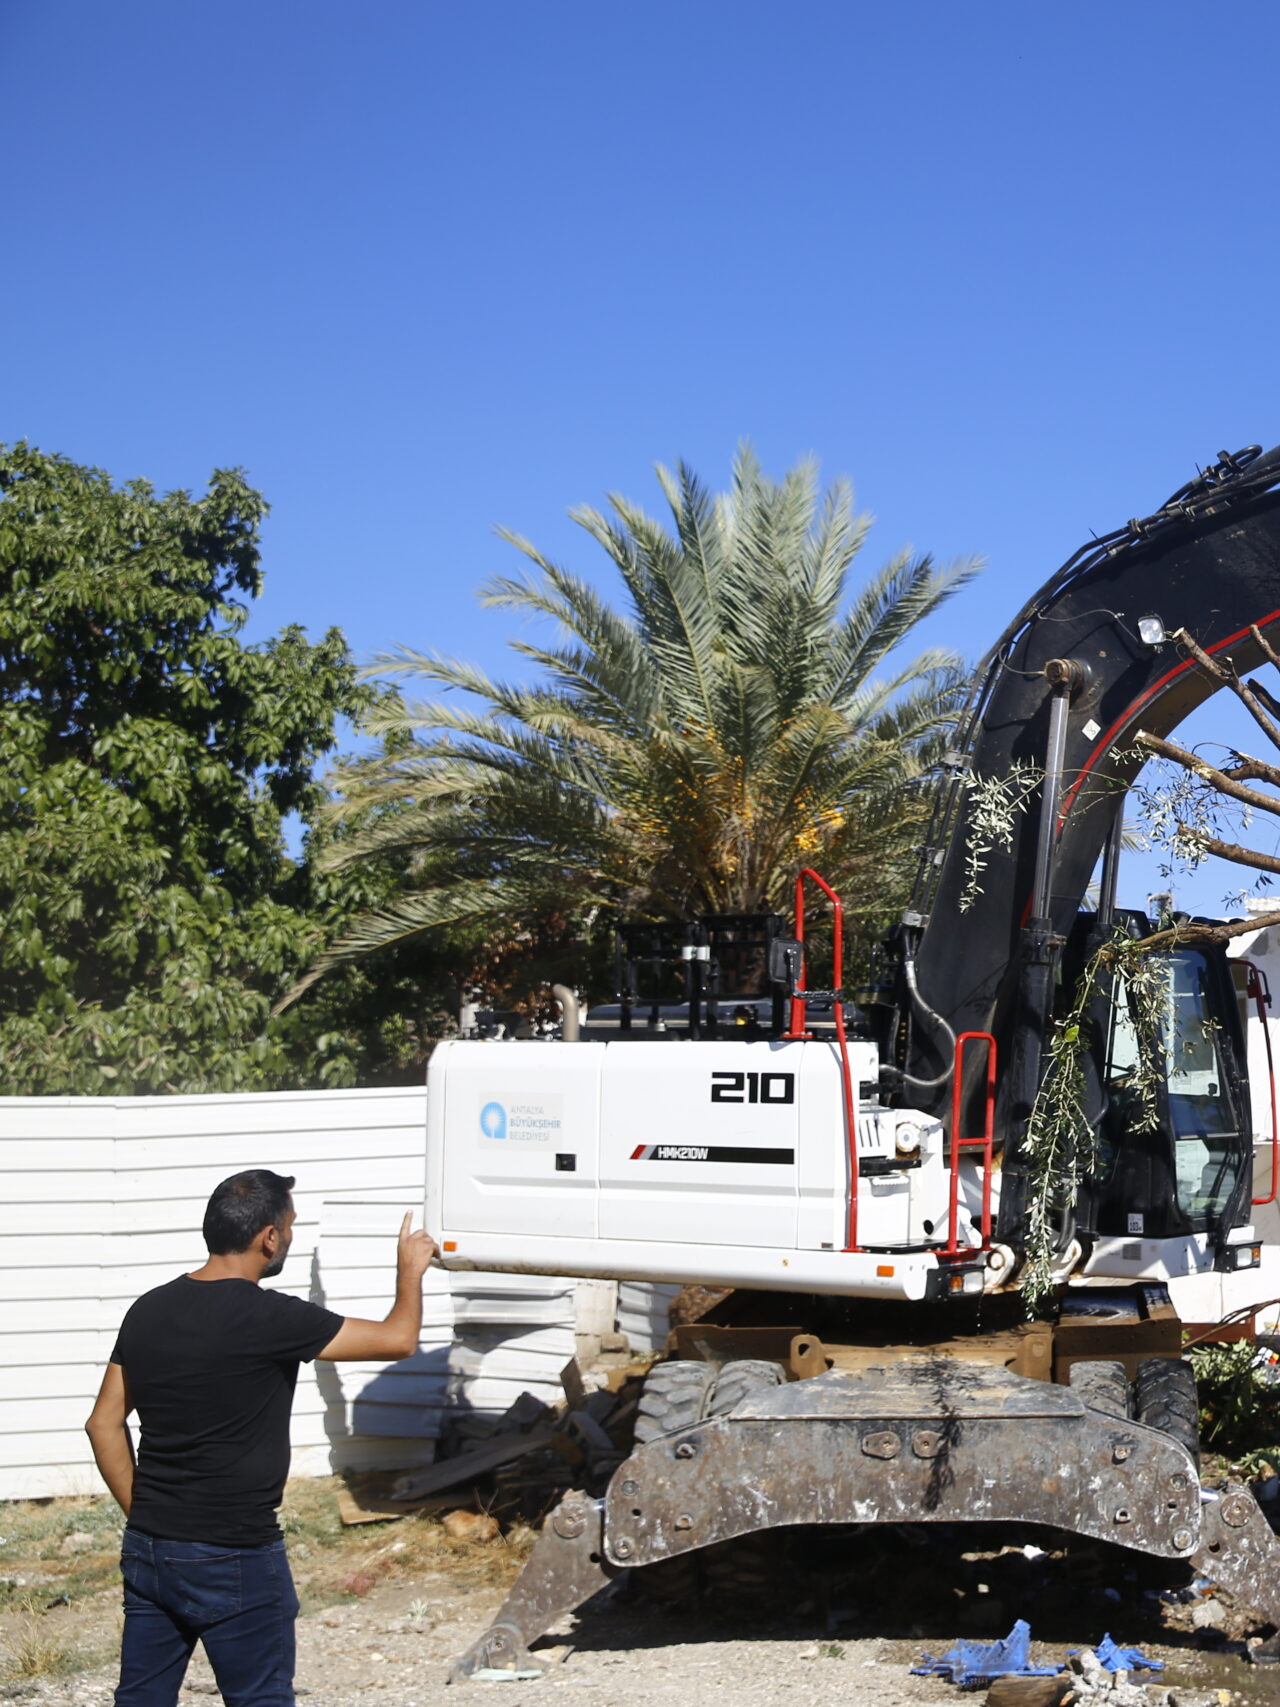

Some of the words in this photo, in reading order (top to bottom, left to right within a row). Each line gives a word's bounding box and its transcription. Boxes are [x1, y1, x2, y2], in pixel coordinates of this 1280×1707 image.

[711, 1072, 795, 1104] 210
[510, 1105, 544, 1113] ANTALYA
[658, 1146, 709, 1160] HMK210W
